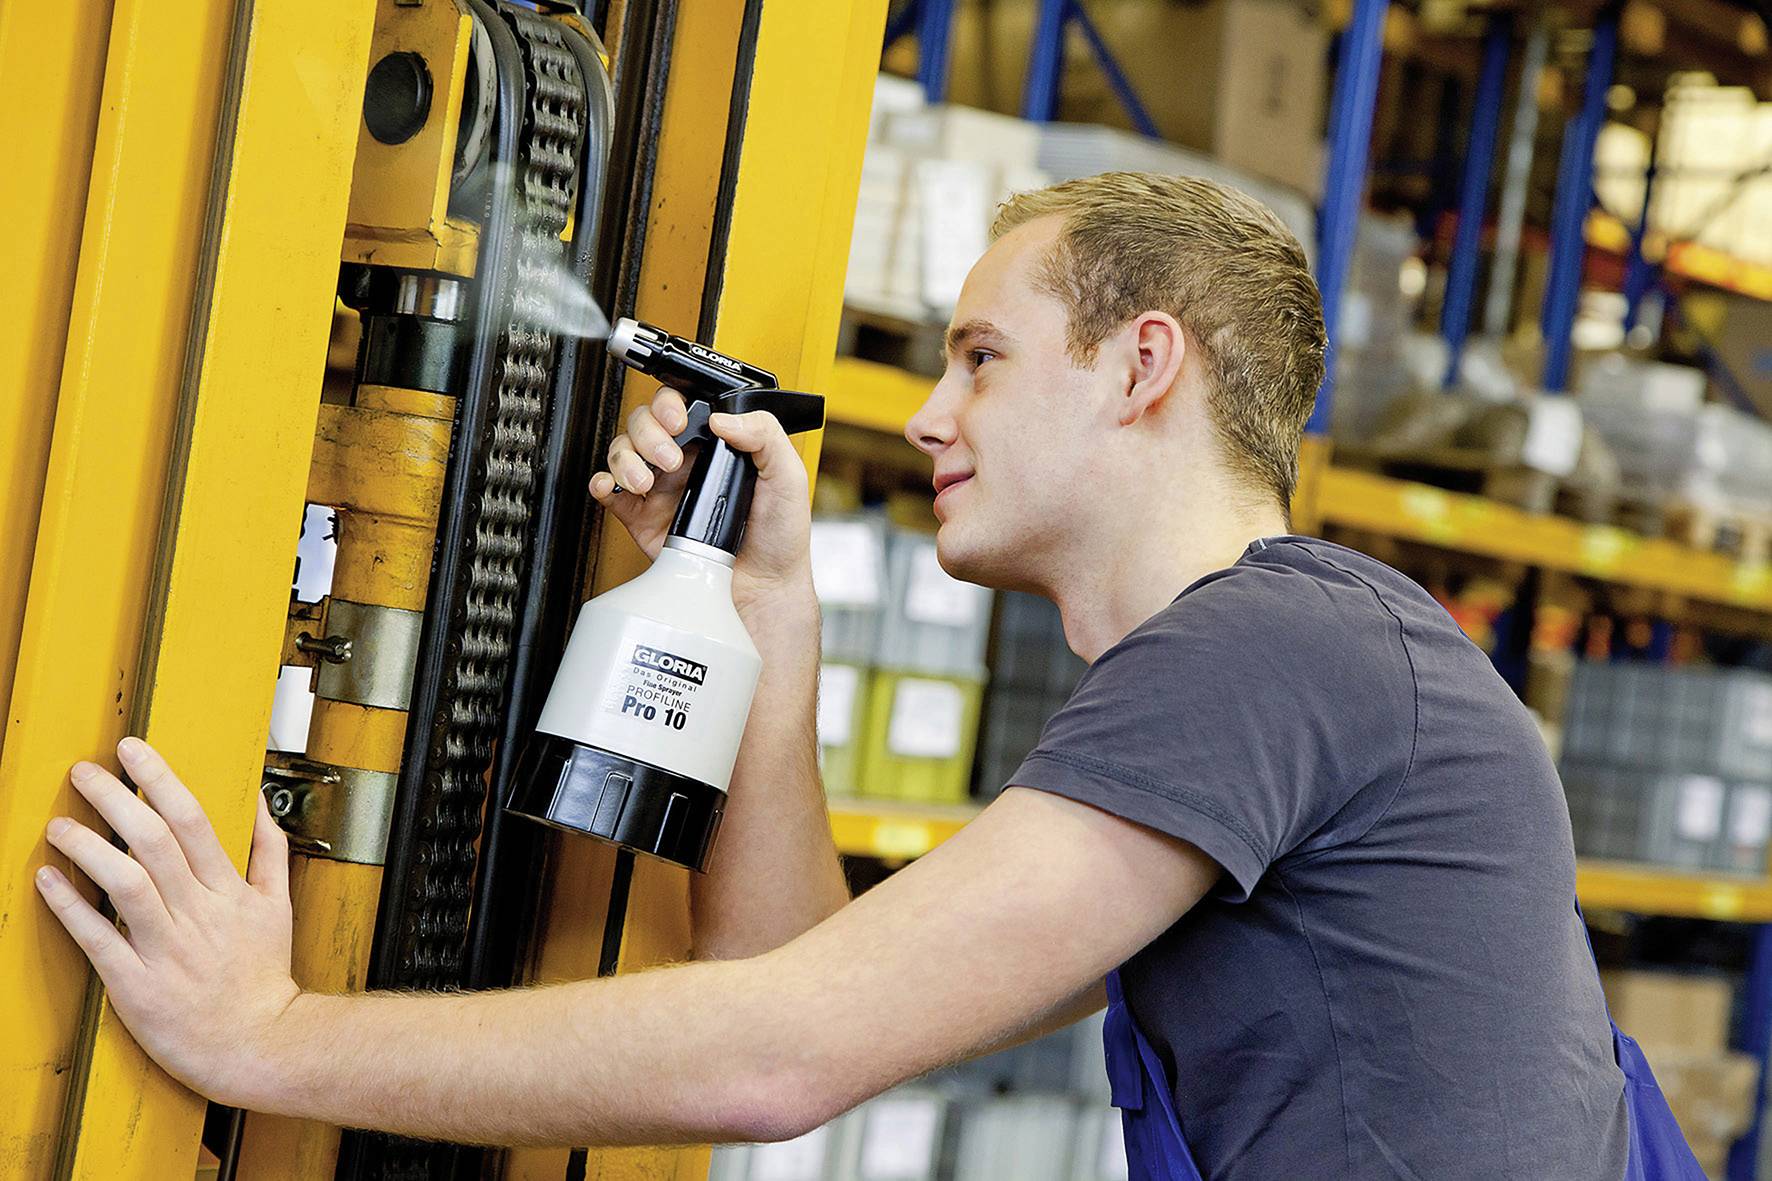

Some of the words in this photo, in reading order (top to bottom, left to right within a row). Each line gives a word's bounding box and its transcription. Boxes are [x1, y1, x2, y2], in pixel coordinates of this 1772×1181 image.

[692, 346, 741, 371] GLORIA
[634, 648, 703, 681] GLORIA
[633, 667, 652, 678] Das
[656, 674, 698, 693] Original
[658, 683, 682, 697] Sprayer
[626, 685, 692, 712] PROFILINE
[621, 695, 657, 721] Pro
[664, 708, 687, 731] 10
